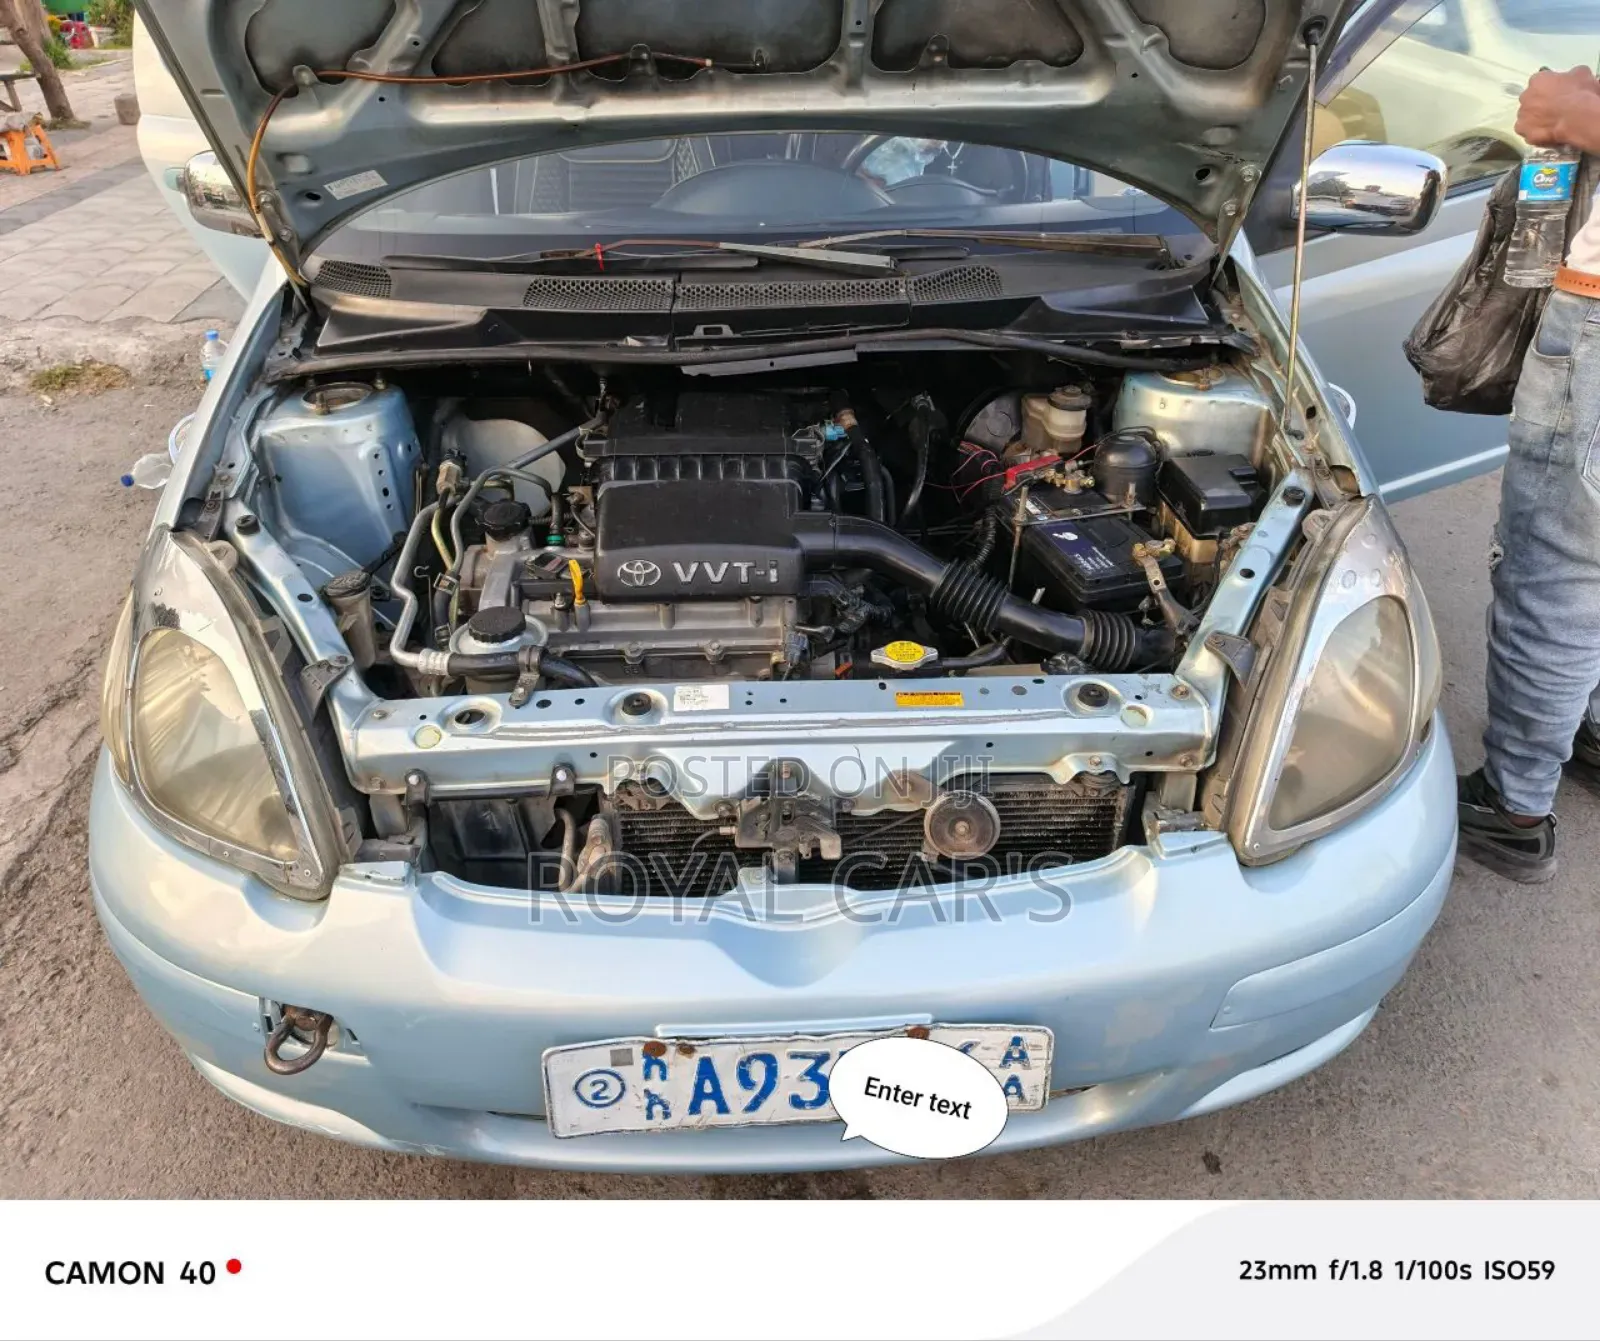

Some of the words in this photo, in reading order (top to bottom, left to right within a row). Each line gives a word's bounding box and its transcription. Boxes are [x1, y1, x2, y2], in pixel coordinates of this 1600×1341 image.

[672, 559, 780, 584] VVT-i
[589, 1078, 608, 1101] 2
[688, 1050, 854, 1116] A93
